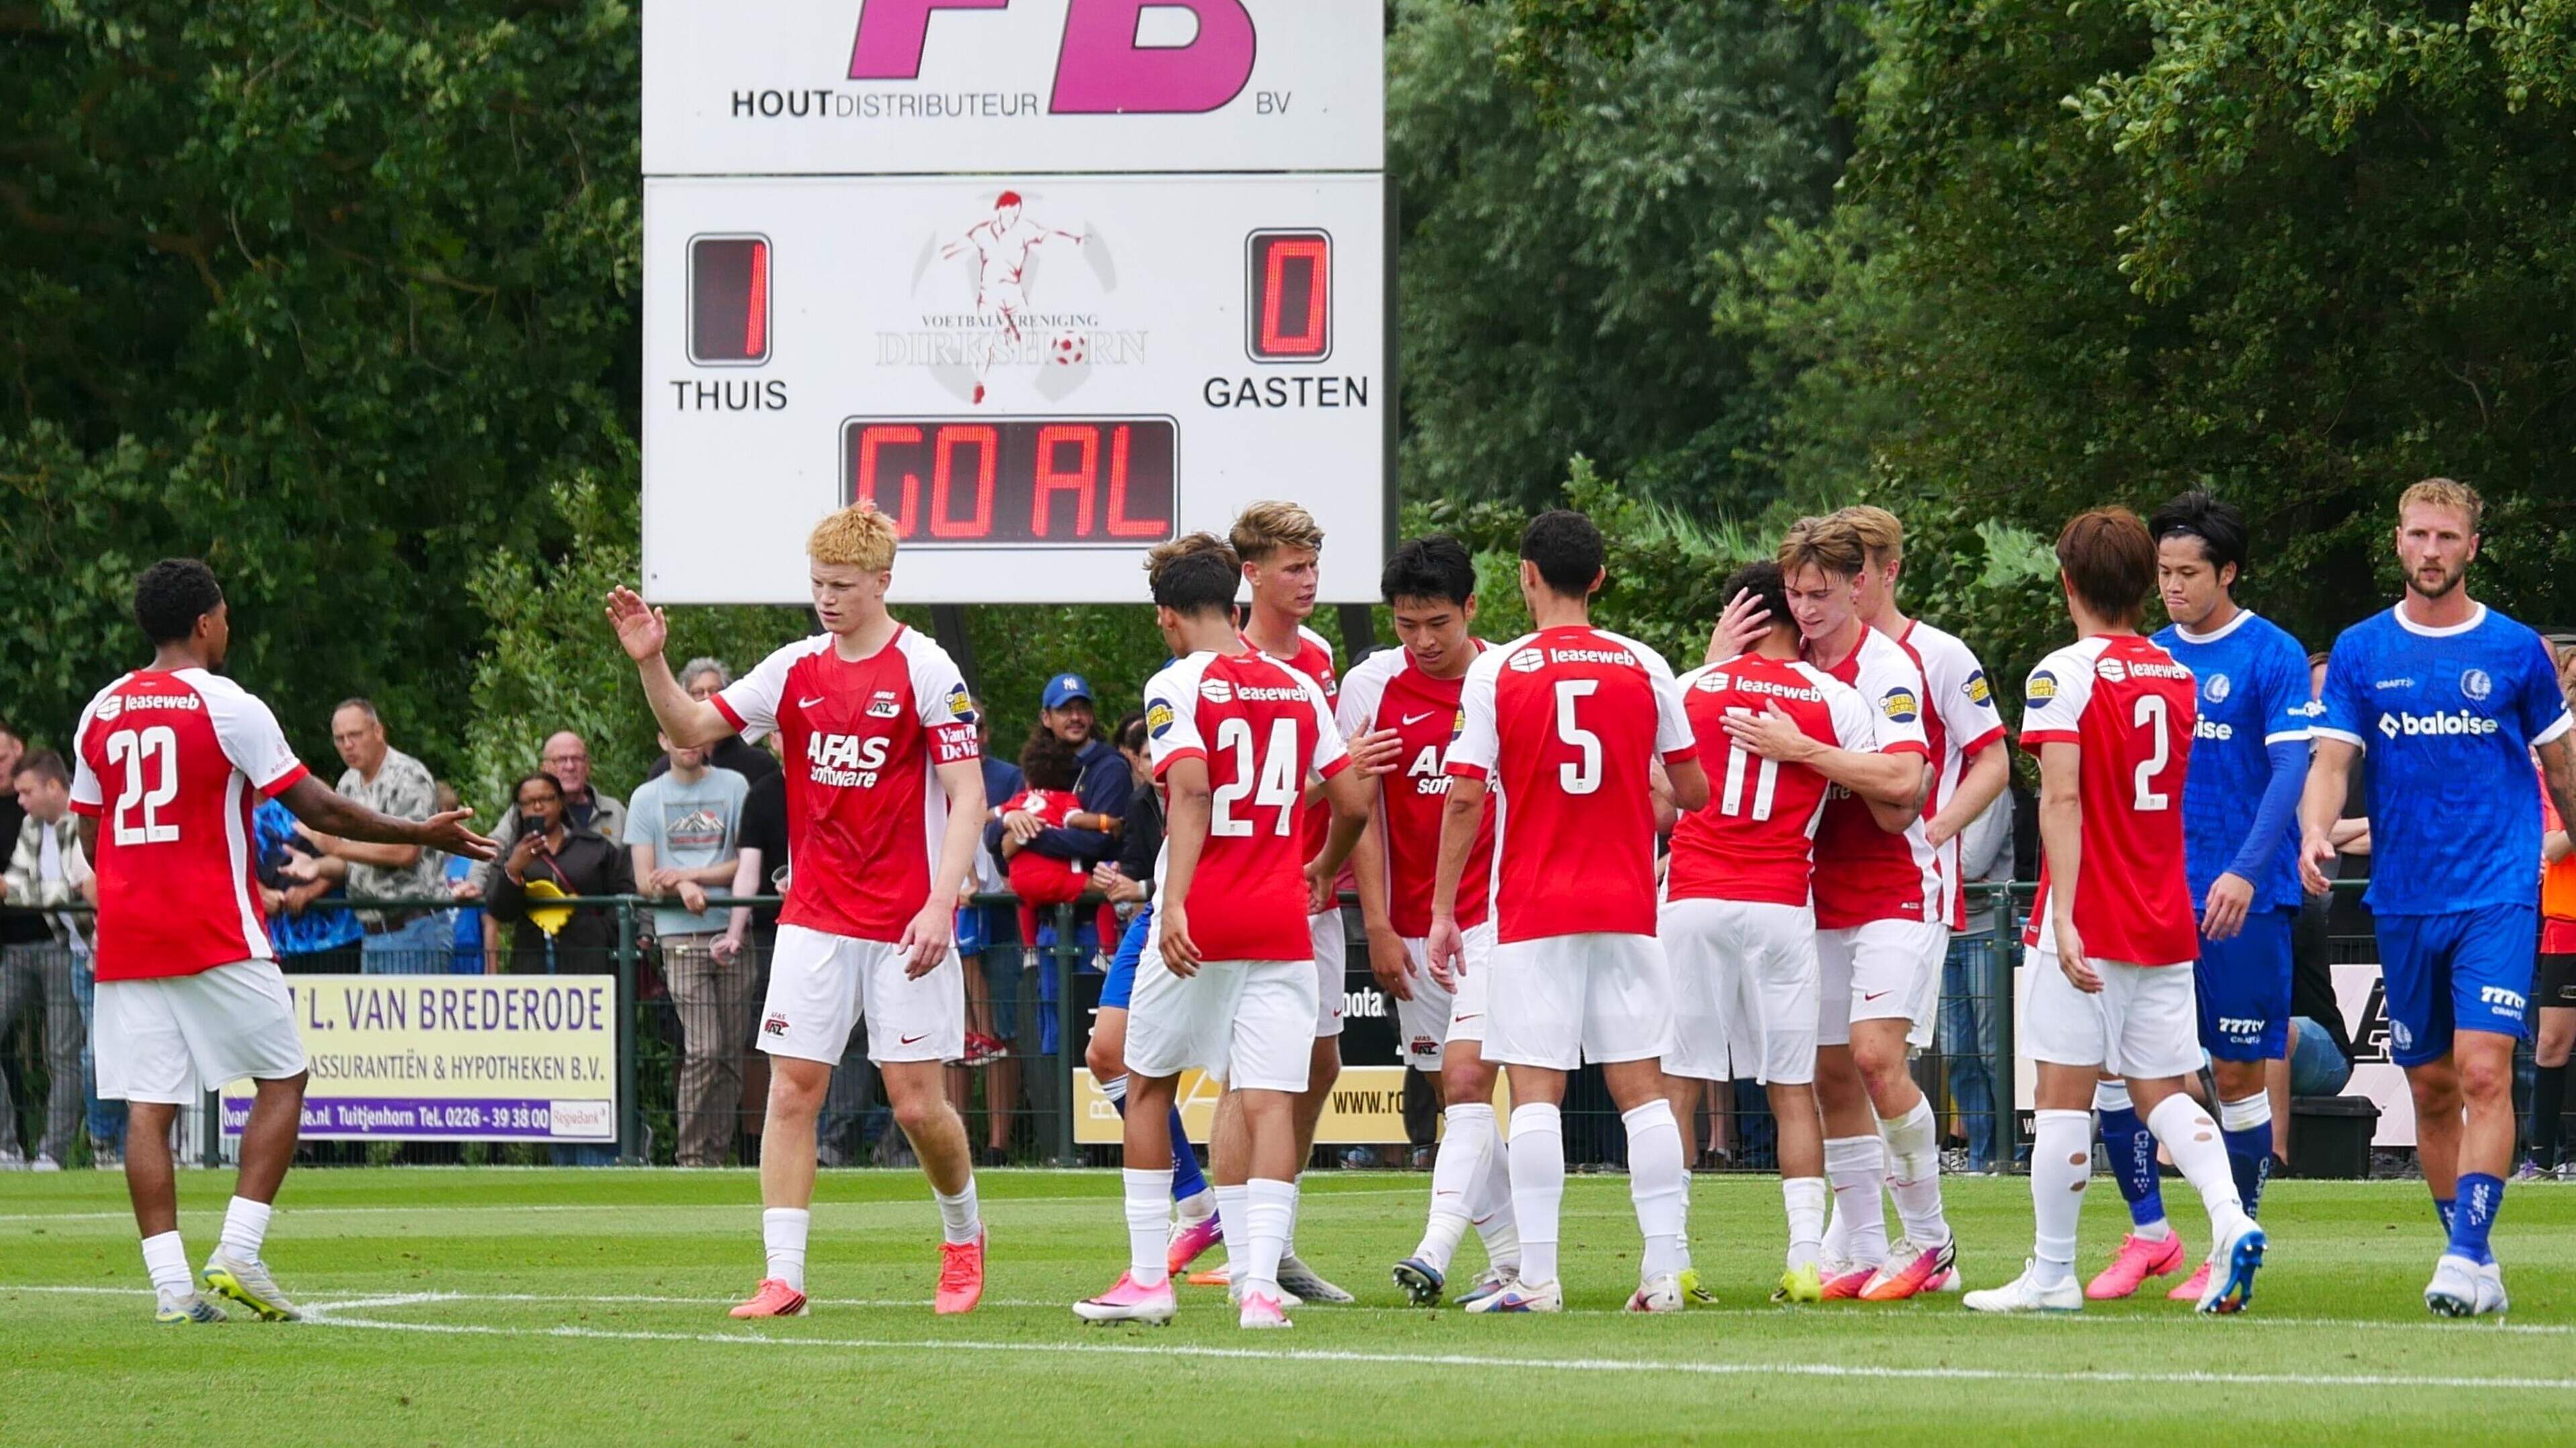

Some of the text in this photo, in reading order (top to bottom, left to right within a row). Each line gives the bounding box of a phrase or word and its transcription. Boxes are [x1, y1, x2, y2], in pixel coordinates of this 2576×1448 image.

[1256, 91, 1291, 115] BV
[744, 242, 766, 356] 1
[1261, 240, 1326, 353] 0
[922, 314, 1099, 327] VOETBALVERENIGING
[669, 380, 788, 411] THUIS
[1203, 376, 1368, 408] GASTEN
[1550, 647, 1635, 667] leaseweb
[124, 693, 200, 712] leaseweb
[1234, 681, 1310, 702] leaseweb
[1735, 675, 1822, 703] leaseweb
[1554, 679, 1602, 795] 5
[2192, 713, 2233, 740] ise
[2401, 709, 2499, 736] baloise
[808, 730, 890, 769] AFAS
[1721, 706, 1778, 822] 11
[2134, 694, 2169, 811] 2
[106, 725, 180, 847] 22
[810, 765, 877, 789] software
[1210, 717, 1299, 837] 24
[344, 987, 407, 1031] VAN
[419, 987, 604, 1032] BREDERODE
[2219, 1016, 2265, 1034] 777tv
[309, 1048, 605, 1081] ASSURANTIËN & HYPOTHEKEN B.V.
[337, 1105, 415, 1132] Tuitjenhorn
[418, 1106, 443, 1127] Tel.
[445, 1107, 481, 1128] 0226
[491, 1107, 511, 1129] 39
[511, 1107, 530, 1129] 38
[531, 1107, 549, 1129] 00
[2134, 1129, 2149, 1177] CRAFT
